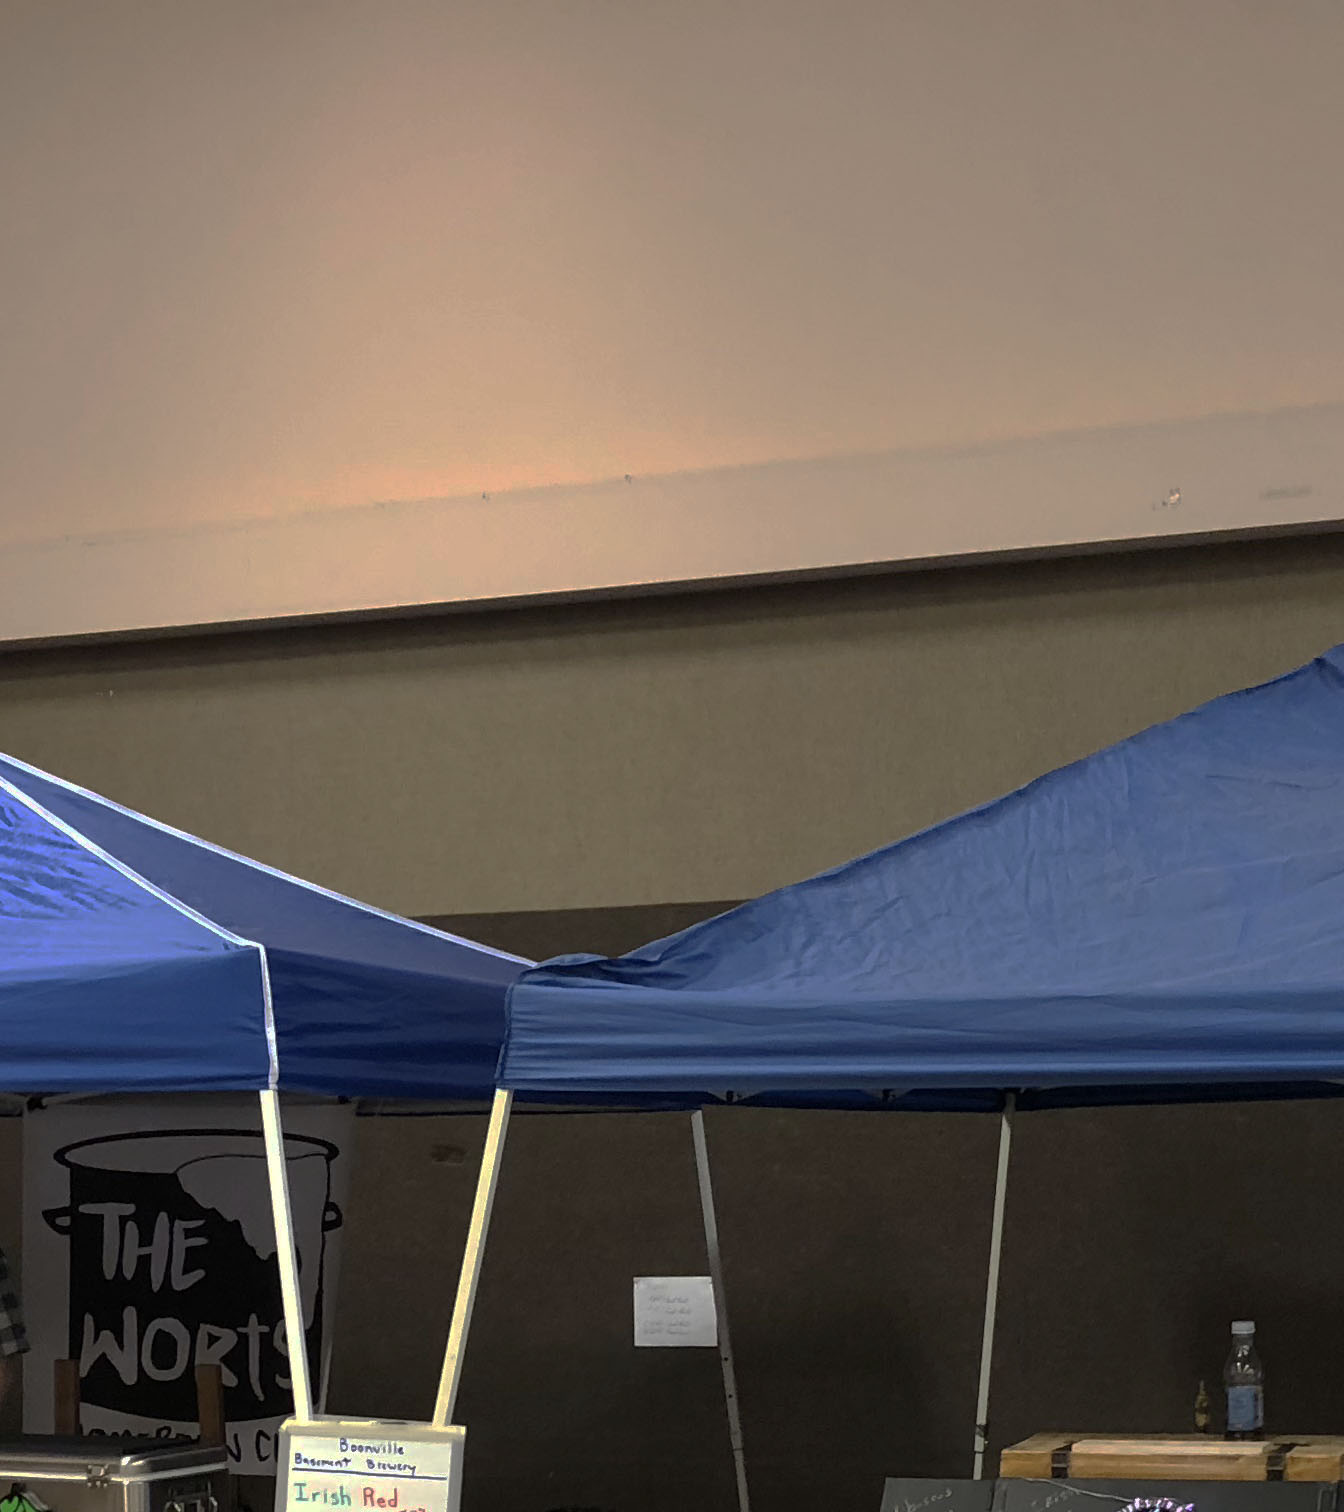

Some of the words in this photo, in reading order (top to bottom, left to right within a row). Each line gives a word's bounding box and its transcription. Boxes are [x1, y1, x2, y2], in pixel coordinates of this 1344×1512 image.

[78, 1202, 209, 1293] THE
[339, 1437, 405, 1456] Boonville
[294, 1453, 351, 1467] Basement
[366, 1458, 417, 1477] Brewery
[293, 1482, 352, 1506] Irish
[363, 1486, 399, 1508] Red
